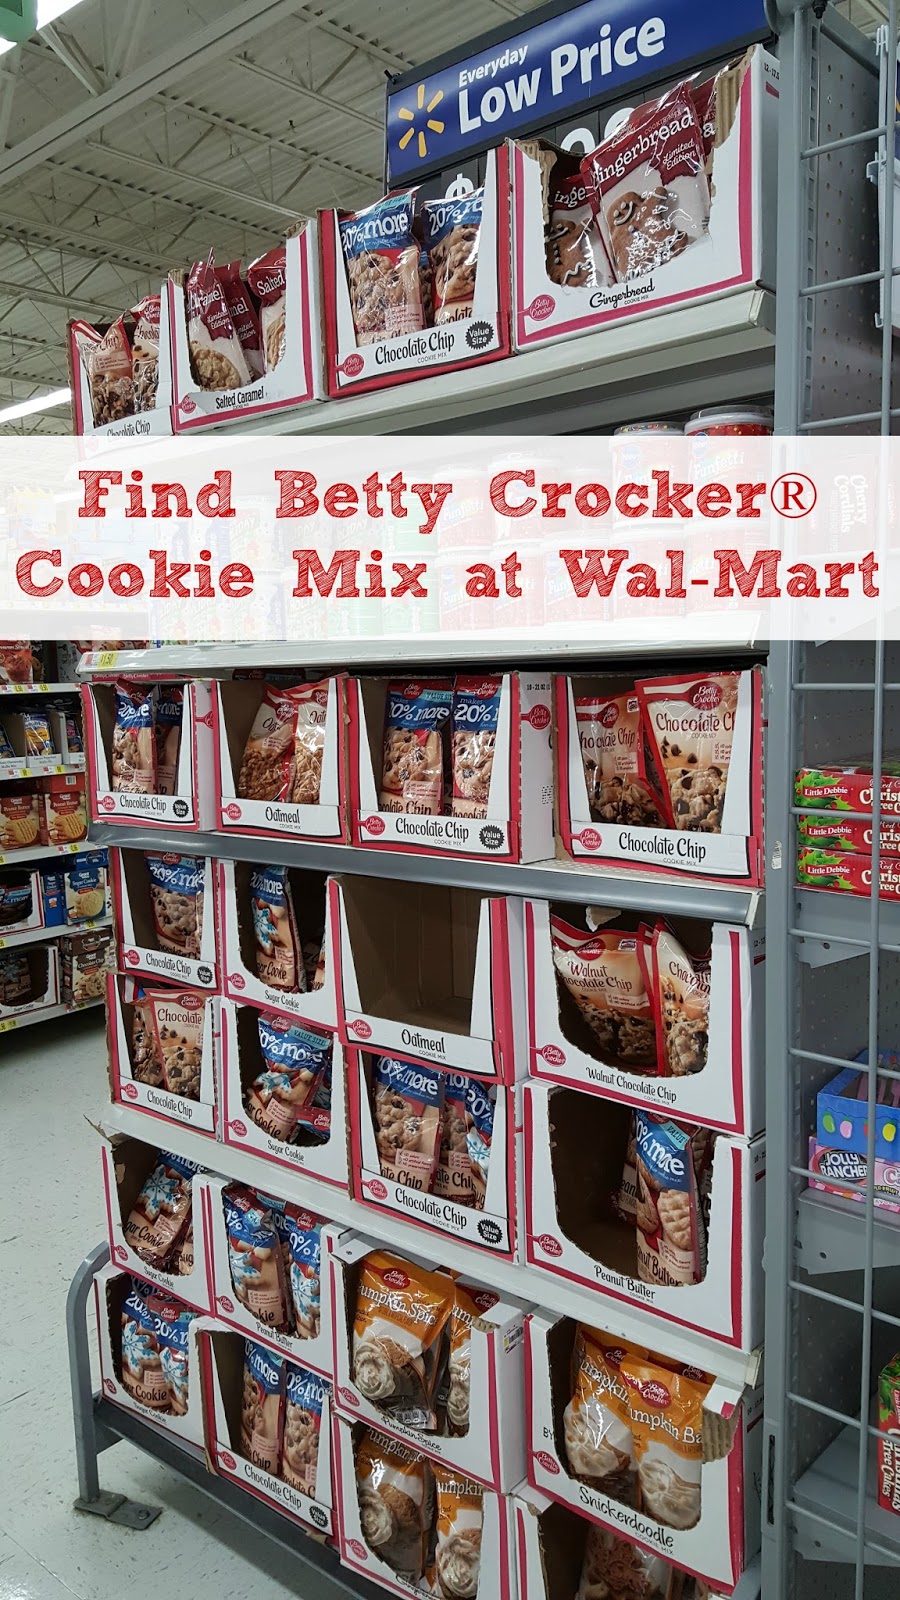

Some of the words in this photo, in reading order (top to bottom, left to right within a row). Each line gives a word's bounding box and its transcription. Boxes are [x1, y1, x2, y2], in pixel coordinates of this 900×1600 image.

[458, 66, 543, 134] Low
[550, 16, 666, 96] Price
[459, 45, 528, 88] Everyday
[663, 140, 695, 164] Limited
[365, 211, 409, 240] more
[429, 203, 462, 237] 20%
[256, 270, 286, 297] Salted
[589, 278, 655, 308] Gingerbread
[468, 327, 490, 338] Value
[471, 336, 488, 347] Size
[375, 338, 427, 365] Chocolate
[428, 331, 455, 351] Chip
[417, 355, 437, 364] COOKIE
[437, 352, 448, 360] MIX
[215, 394, 236, 410] Salted
[237, 386, 264, 404] Caramel
[135, 418, 152, 436] Chip
[692, 693, 720, 704] Crocker
[698, 686, 717, 697] Betty
[415, 704, 450, 720] more
[455, 704, 494, 723] 20%
[656, 712, 719, 732] Chocolate
[617, 726, 636, 747] Chip
[805, 787, 823, 796] Little
[824, 786, 848, 796] Debbie
[120, 795, 150, 809] Chocolate
[151, 797, 166, 814] Chip
[265, 806, 301, 825] Oatmeal
[396, 817, 444, 838] Chocolate
[445, 820, 470, 843] Chip
[483, 831, 501, 840] Value
[808, 827, 827, 835] Little
[828, 826, 852, 835] Debbie
[434, 838, 452, 846] COOKIE
[485, 837, 499, 846] Size
[619, 832, 675, 856] Chocolate
[676, 838, 706, 863] Chip
[663, 858, 685, 866] COOKIE
[807, 866, 825, 875] Little
[826, 866, 850, 875] Debbie
[264, 877, 283, 896] more
[146, 952, 176, 971] Chocolate
[176, 960, 192, 979] Chip
[567, 960, 608, 978] Walnut
[606, 977, 633, 992] Chip
[264, 990, 281, 1004] Sugar
[281, 994, 300, 1009] Cookie
[157, 1008, 202, 1025] Chocolate
[293, 1029, 310, 1041] VALUE
[401, 1028, 446, 1054] Oatmeal
[280, 1042, 324, 1062] more
[418, 1050, 437, 1059] COOKIE
[403, 1067, 439, 1096] more
[586, 1066, 615, 1085] Walnut
[616, 1074, 656, 1096] Chocolate
[656, 1085, 677, 1104] Chip
[147, 1089, 178, 1112] Chocolate
[178, 1101, 193, 1119] Chip
[254, 1107, 282, 1139] Cookie
[666, 1122, 686, 1144] VALUE
[267, 1139, 284, 1155] Sugar
[284, 1146, 305, 1162] Cookie
[648, 1137, 686, 1178] more
[825, 1152, 860, 1166] JOLLY
[395, 1187, 442, 1218] Chocolate
[443, 1206, 467, 1230] Chip
[432, 1218, 450, 1228] COOKIE
[480, 1222, 500, 1235] Value
[483, 1230, 498, 1241] Size
[383, 1273, 406, 1288] Crocker
[391, 1270, 405, 1282] Betty
[594, 1263, 625, 1288] Peanut
[627, 1277, 655, 1300] Butter
[255, 1320, 274, 1341] Peanut
[254, 1353, 279, 1386] more
[135, 1384, 168, 1402] Cookie
[649, 1383, 666, 1398] Betty
[369, 1429, 411, 1461] umpkin
[252, 1450, 271, 1469] Chip
[244, 1463, 283, 1499] Chocolate
[283, 1487, 302, 1509] Chip
[579, 1485, 674, 1547] Snickerdoodle
[634, 1532, 660, 1548] COOKIE
[660, 1547, 675, 1556] MIX
